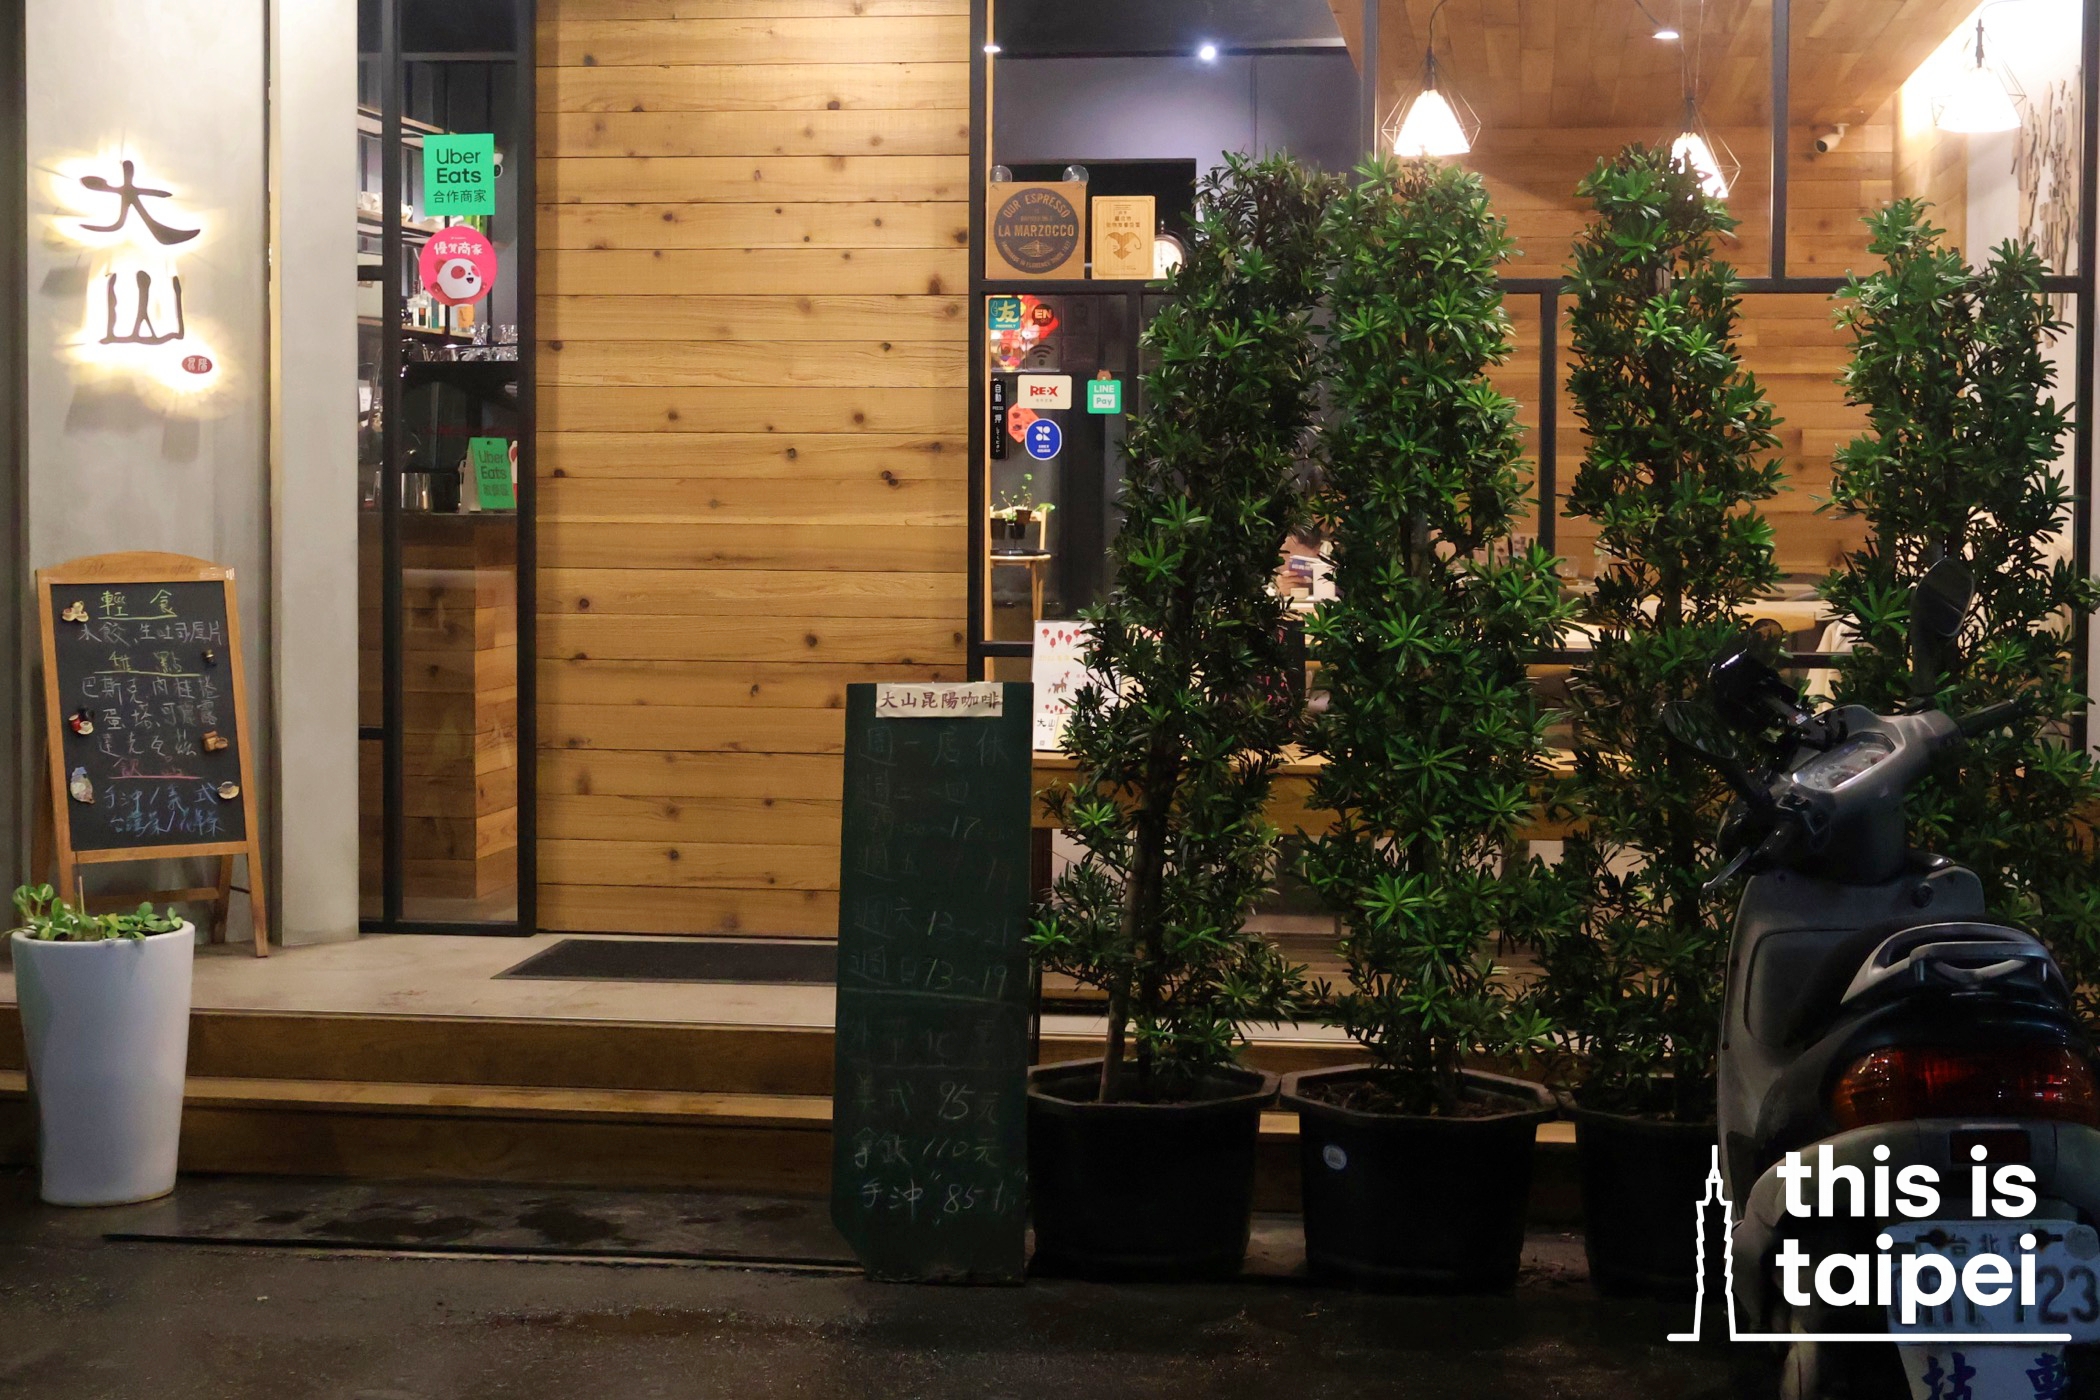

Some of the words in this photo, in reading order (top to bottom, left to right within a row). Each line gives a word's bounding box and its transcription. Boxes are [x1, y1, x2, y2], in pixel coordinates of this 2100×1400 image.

[436, 149, 481, 165] Uber
[437, 168, 482, 184] Eats
[433, 190, 487, 203] 合作商家
[1003, 200, 1021, 218] OUR
[1024, 193, 1070, 218] ESPRESSO
[998, 225, 1011, 236] LA
[1014, 225, 1075, 237] MARZOCCO
[79, 160, 201, 345] 大山
[996, 300, 1019, 322] 友
[1034, 309, 1052, 319] EN
[1093, 385, 1115, 393] LINE
[1096, 397, 1113, 406] Pay
[478, 450, 504, 464] Uber
[480, 466, 507, 480] Eats
[880, 691, 1003, 710] 大山昆陽咖啡
